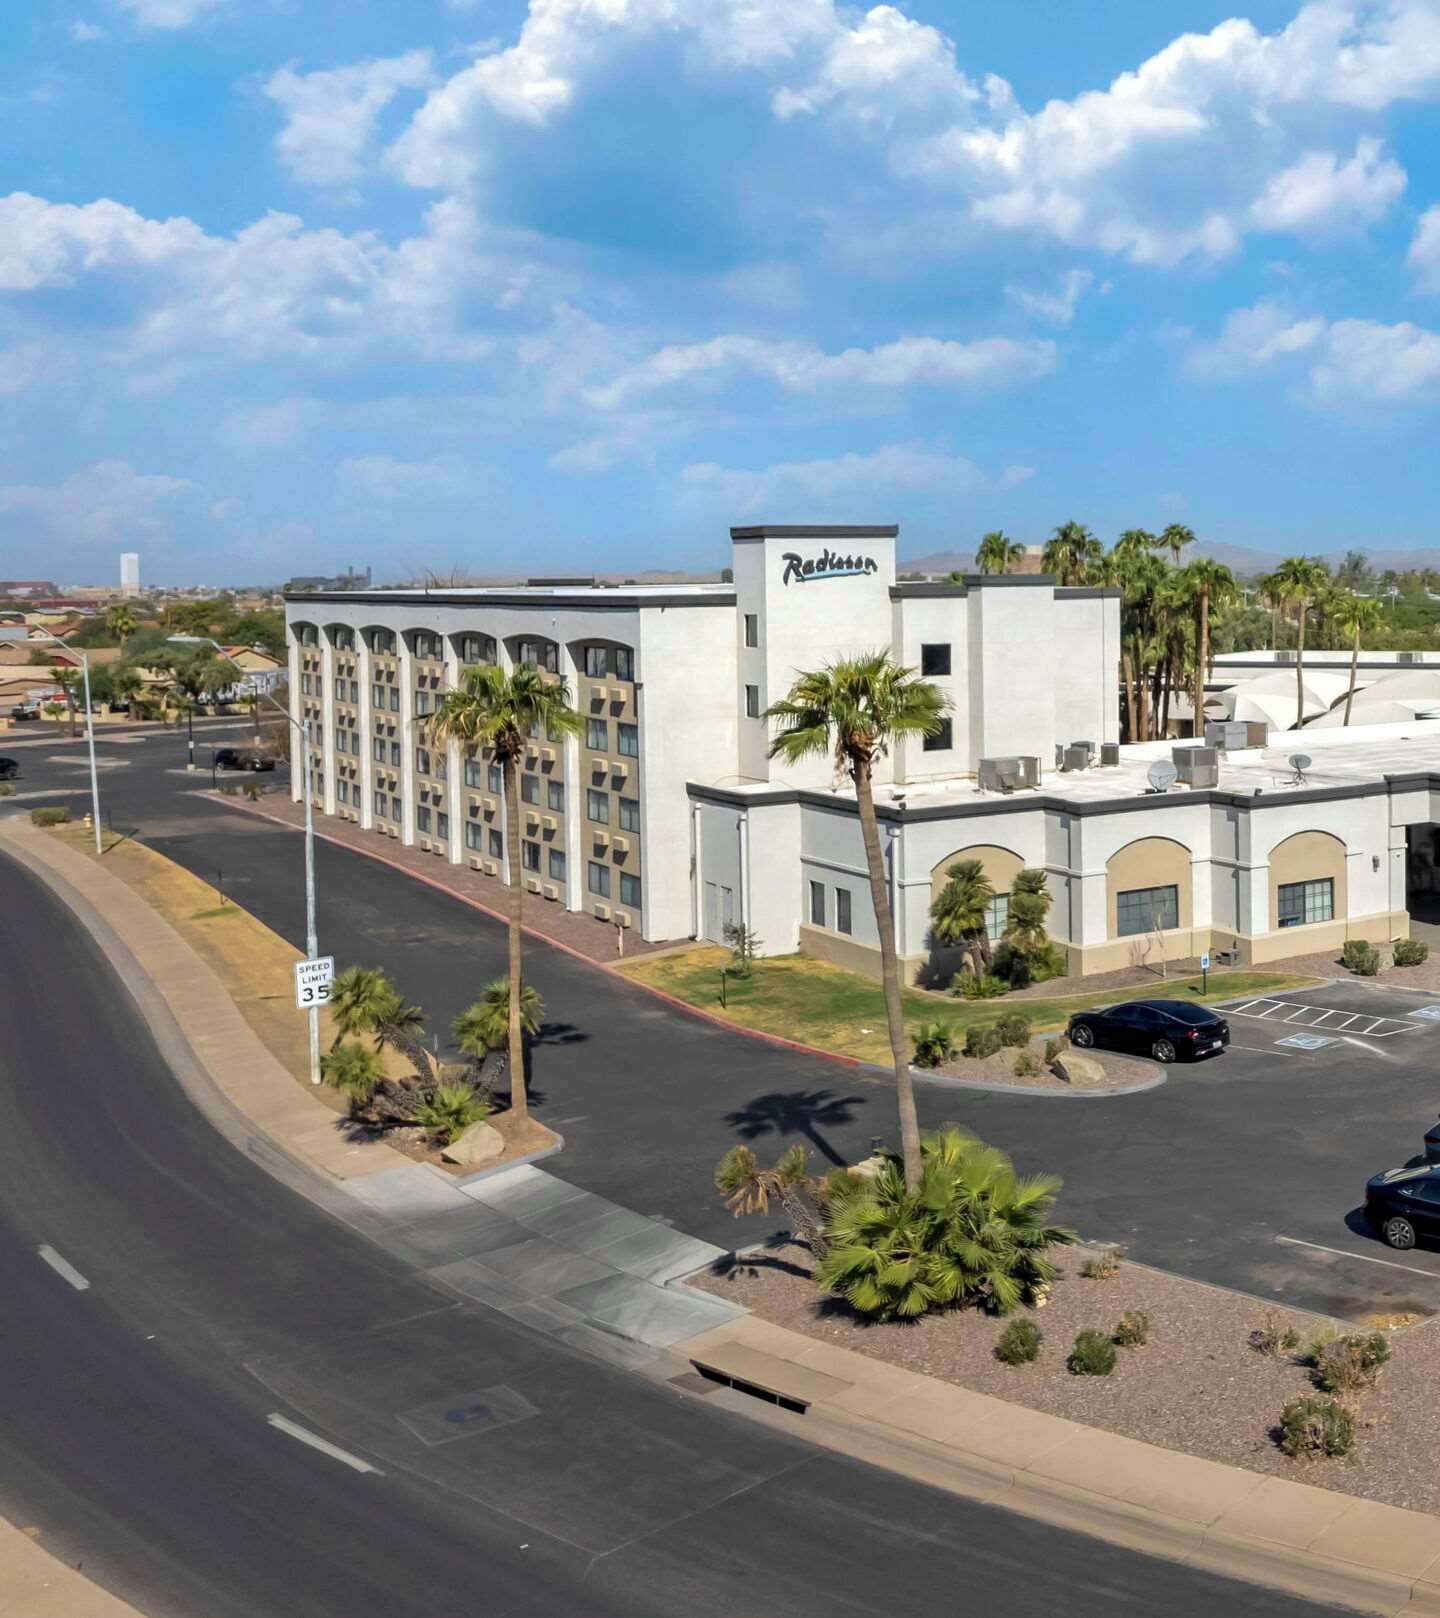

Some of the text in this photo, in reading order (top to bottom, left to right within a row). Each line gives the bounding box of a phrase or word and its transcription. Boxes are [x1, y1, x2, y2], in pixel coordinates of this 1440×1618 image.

[782, 548, 878, 586] Radisson
[298, 962, 330, 974] SPEED
[302, 974, 327, 984] LIMIT
[302, 984, 330, 1002] 35
